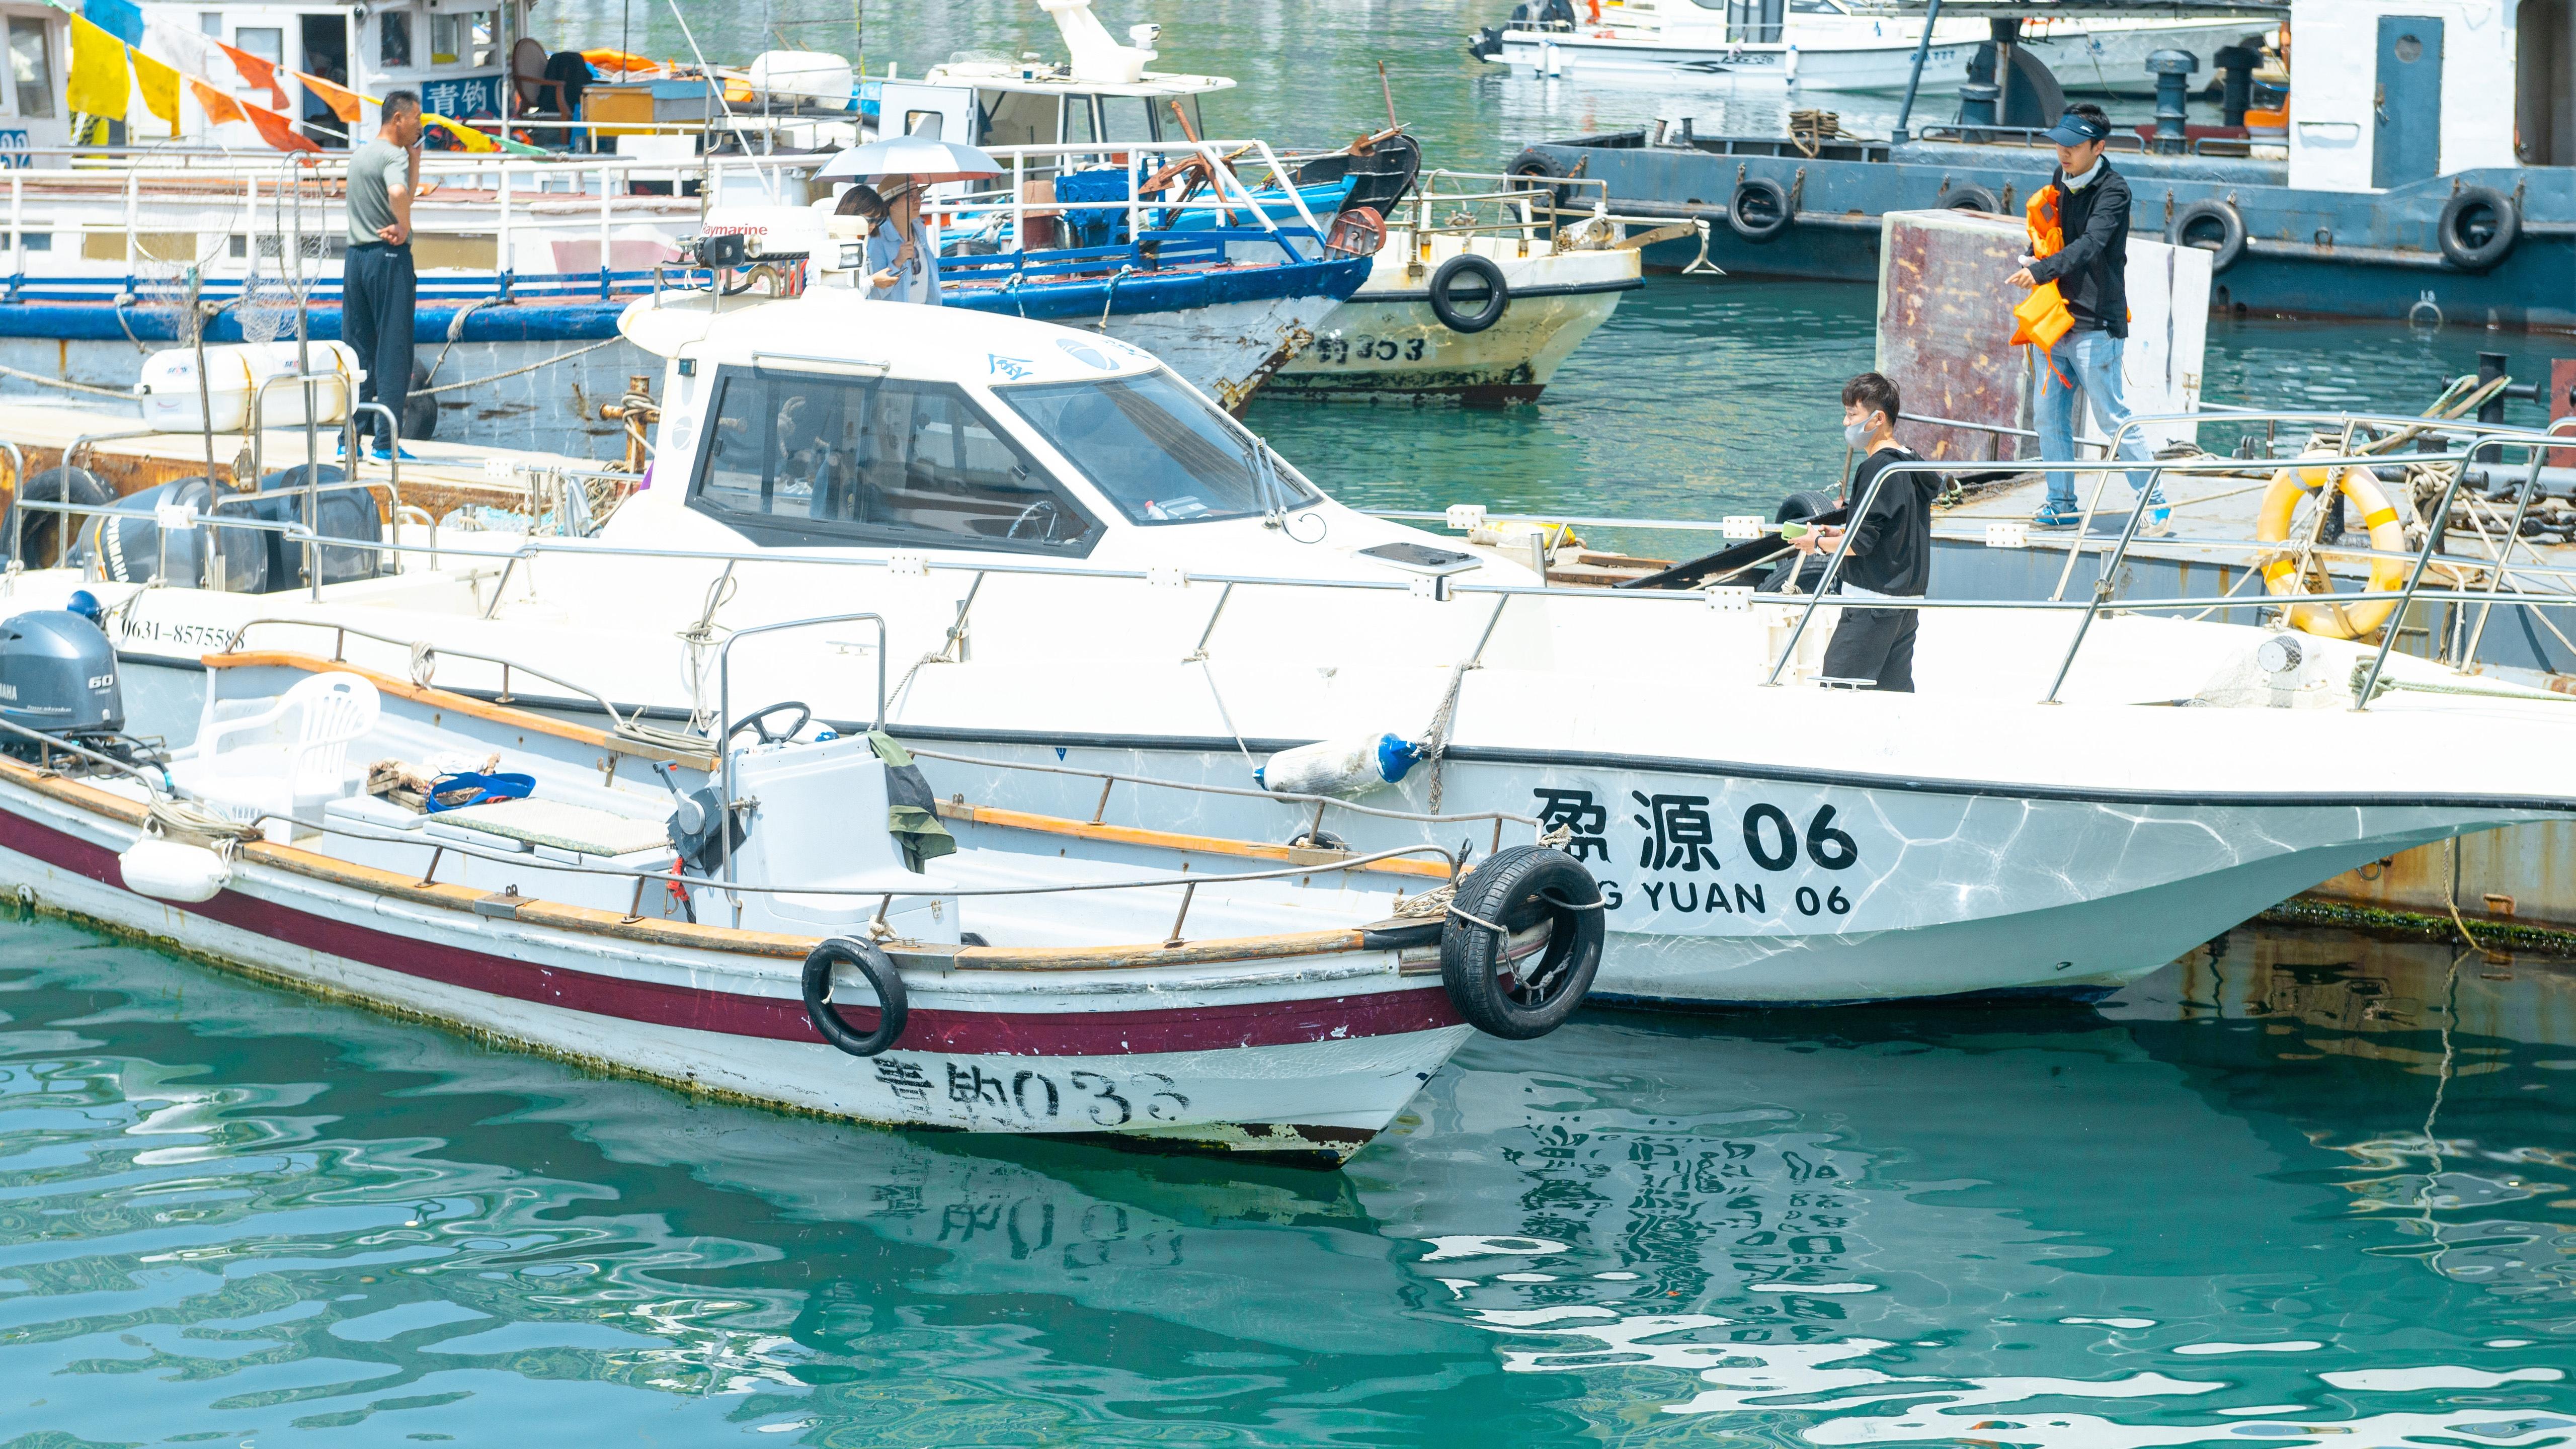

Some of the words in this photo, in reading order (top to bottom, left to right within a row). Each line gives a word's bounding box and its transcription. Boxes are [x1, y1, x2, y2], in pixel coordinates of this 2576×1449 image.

[702, 223, 768, 237] Raymarine
[107, 523, 129, 582] YAMAHA
[121, 618, 245, 650] 0631-8575588
[88, 674, 114, 689] 60
[1641, 881, 1765, 914] YUAN
[1795, 886, 1851, 916] 06
